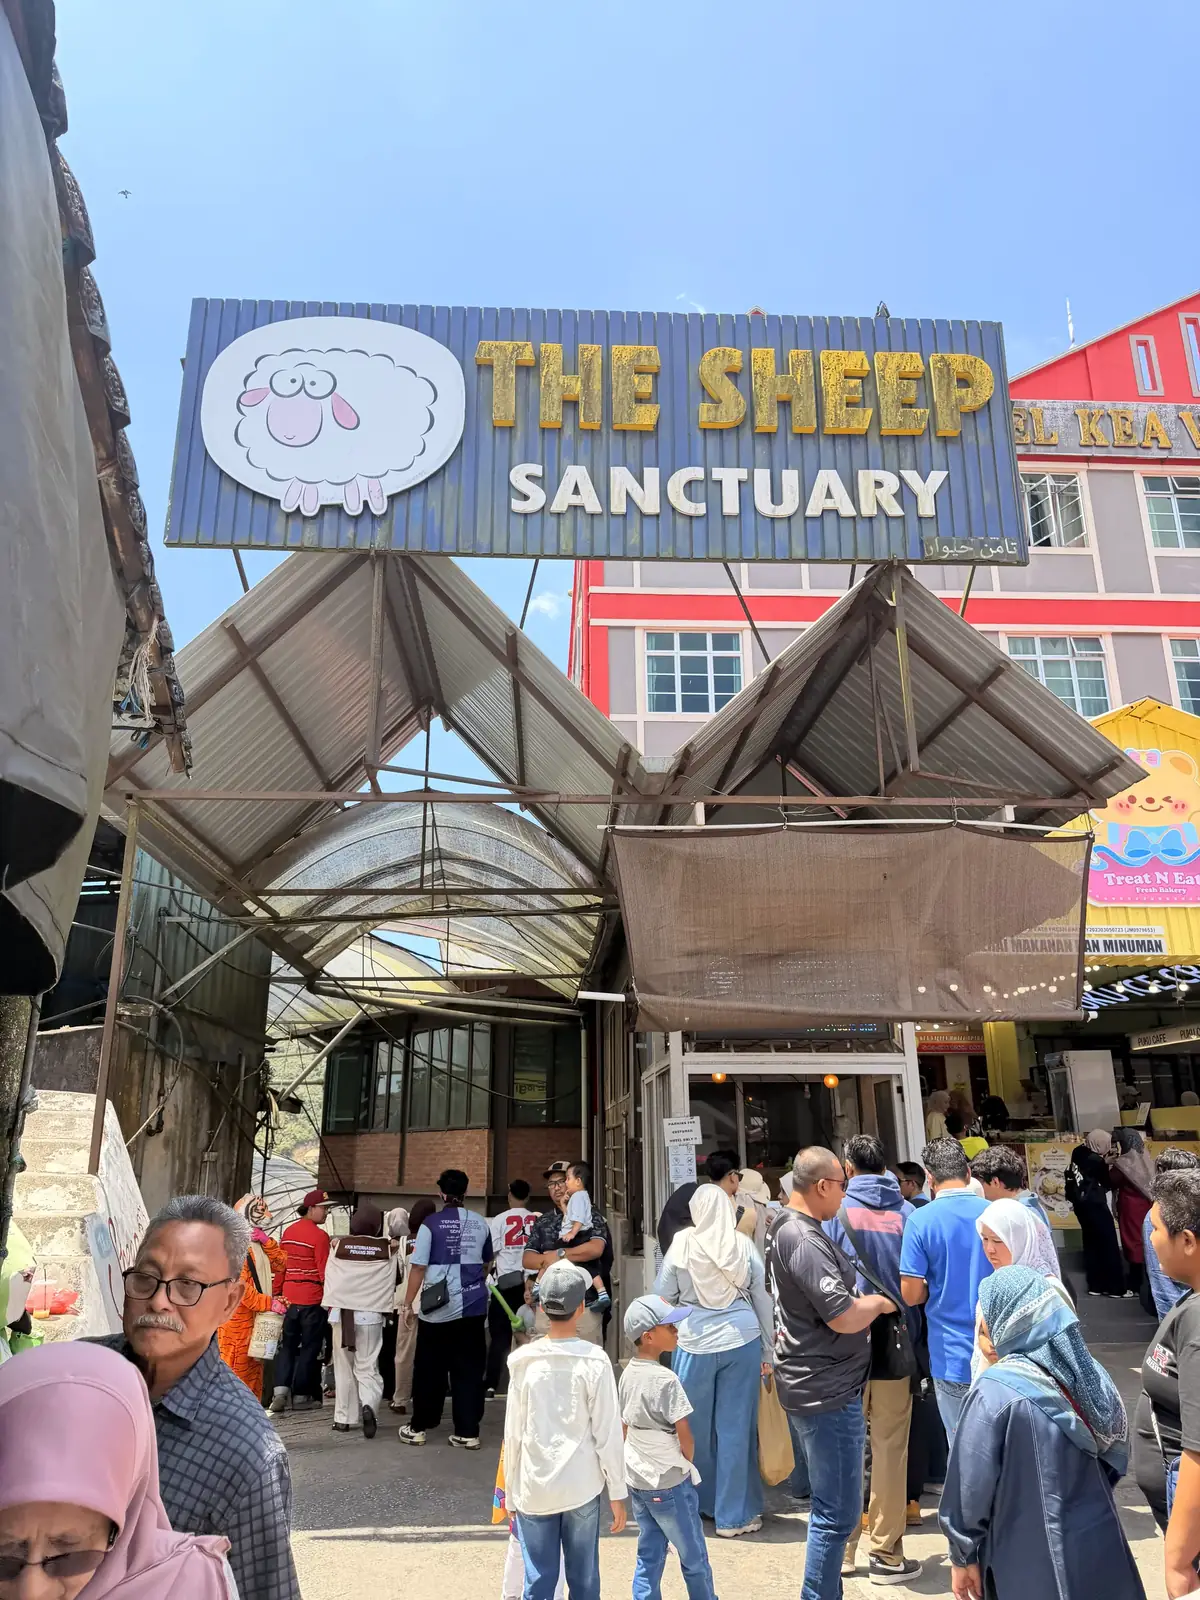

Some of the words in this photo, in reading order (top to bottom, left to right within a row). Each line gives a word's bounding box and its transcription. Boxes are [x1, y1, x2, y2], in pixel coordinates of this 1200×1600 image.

[474, 340, 661, 432] THE
[698, 346, 995, 437] SHEEP
[1075, 408, 1173, 449] KEA
[509, 463, 949, 518] SANCTUARY
[1104, 872, 1151, 886] Treat
[1154, 871, 1169, 885] N
[1135, 886, 1157, 894] Fresh
[1159, 886, 1187, 895] Bakery
[1011, 938, 1073, 952] MAKANAN
[1102, 939, 1164, 953] MINUMAN
[1152, 1033, 1167, 1045] CAFE
